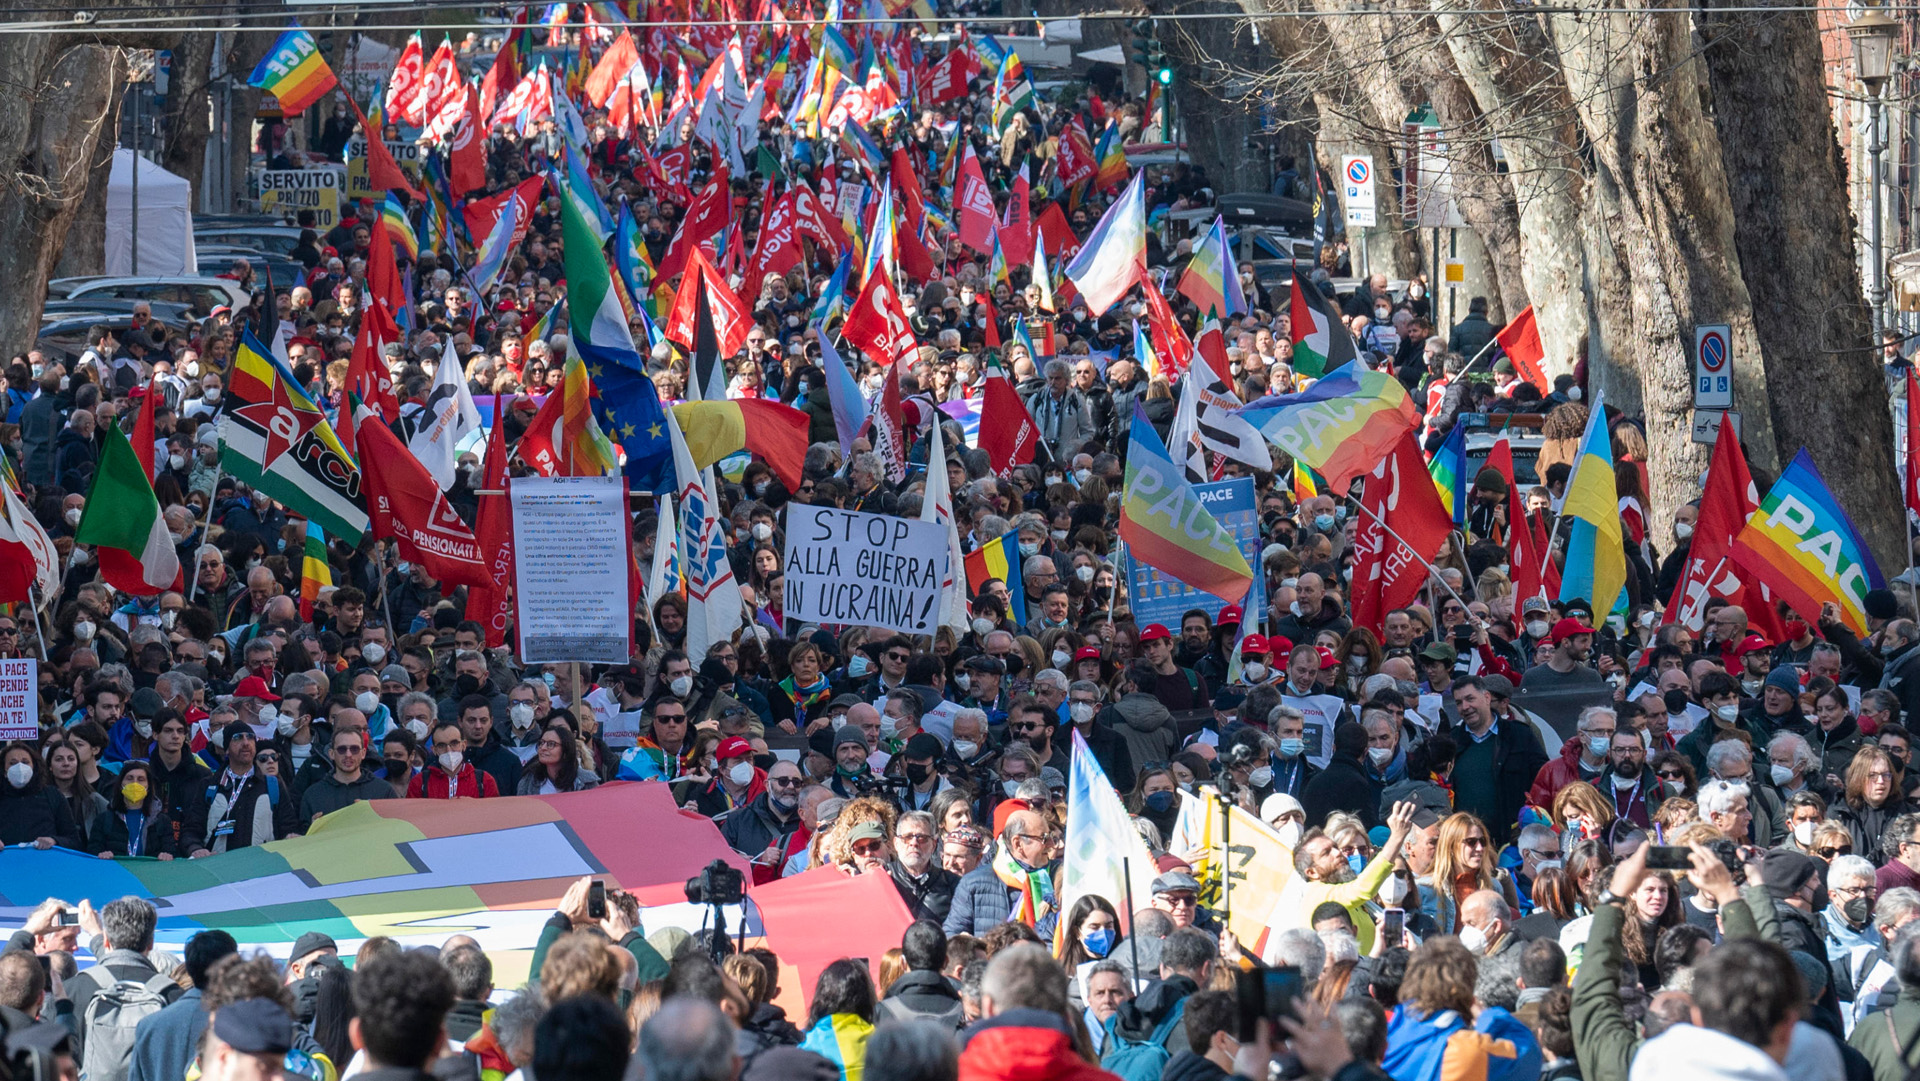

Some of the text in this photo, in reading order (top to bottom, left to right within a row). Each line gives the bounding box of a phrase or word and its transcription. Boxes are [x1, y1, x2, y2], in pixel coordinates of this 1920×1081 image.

[352, 142, 417, 159] SEITO
[262, 173, 335, 189] SERVITO
[1009, 192, 1021, 226] CGIL
[1200, 388, 1213, 403] Un
[1273, 397, 1374, 463] PAC
[270, 405, 361, 498] arci
[1200, 488, 1233, 503] PACE
[413, 529, 474, 559] PENSIONATI
[812, 509, 909, 551] STOP
[786, 545, 937, 590] ALLA GUERRA
[786, 579, 935, 629] IN UCRAINA!
[5, 662, 28, 676] PACE
[0, 679, 29, 691] PENDE
